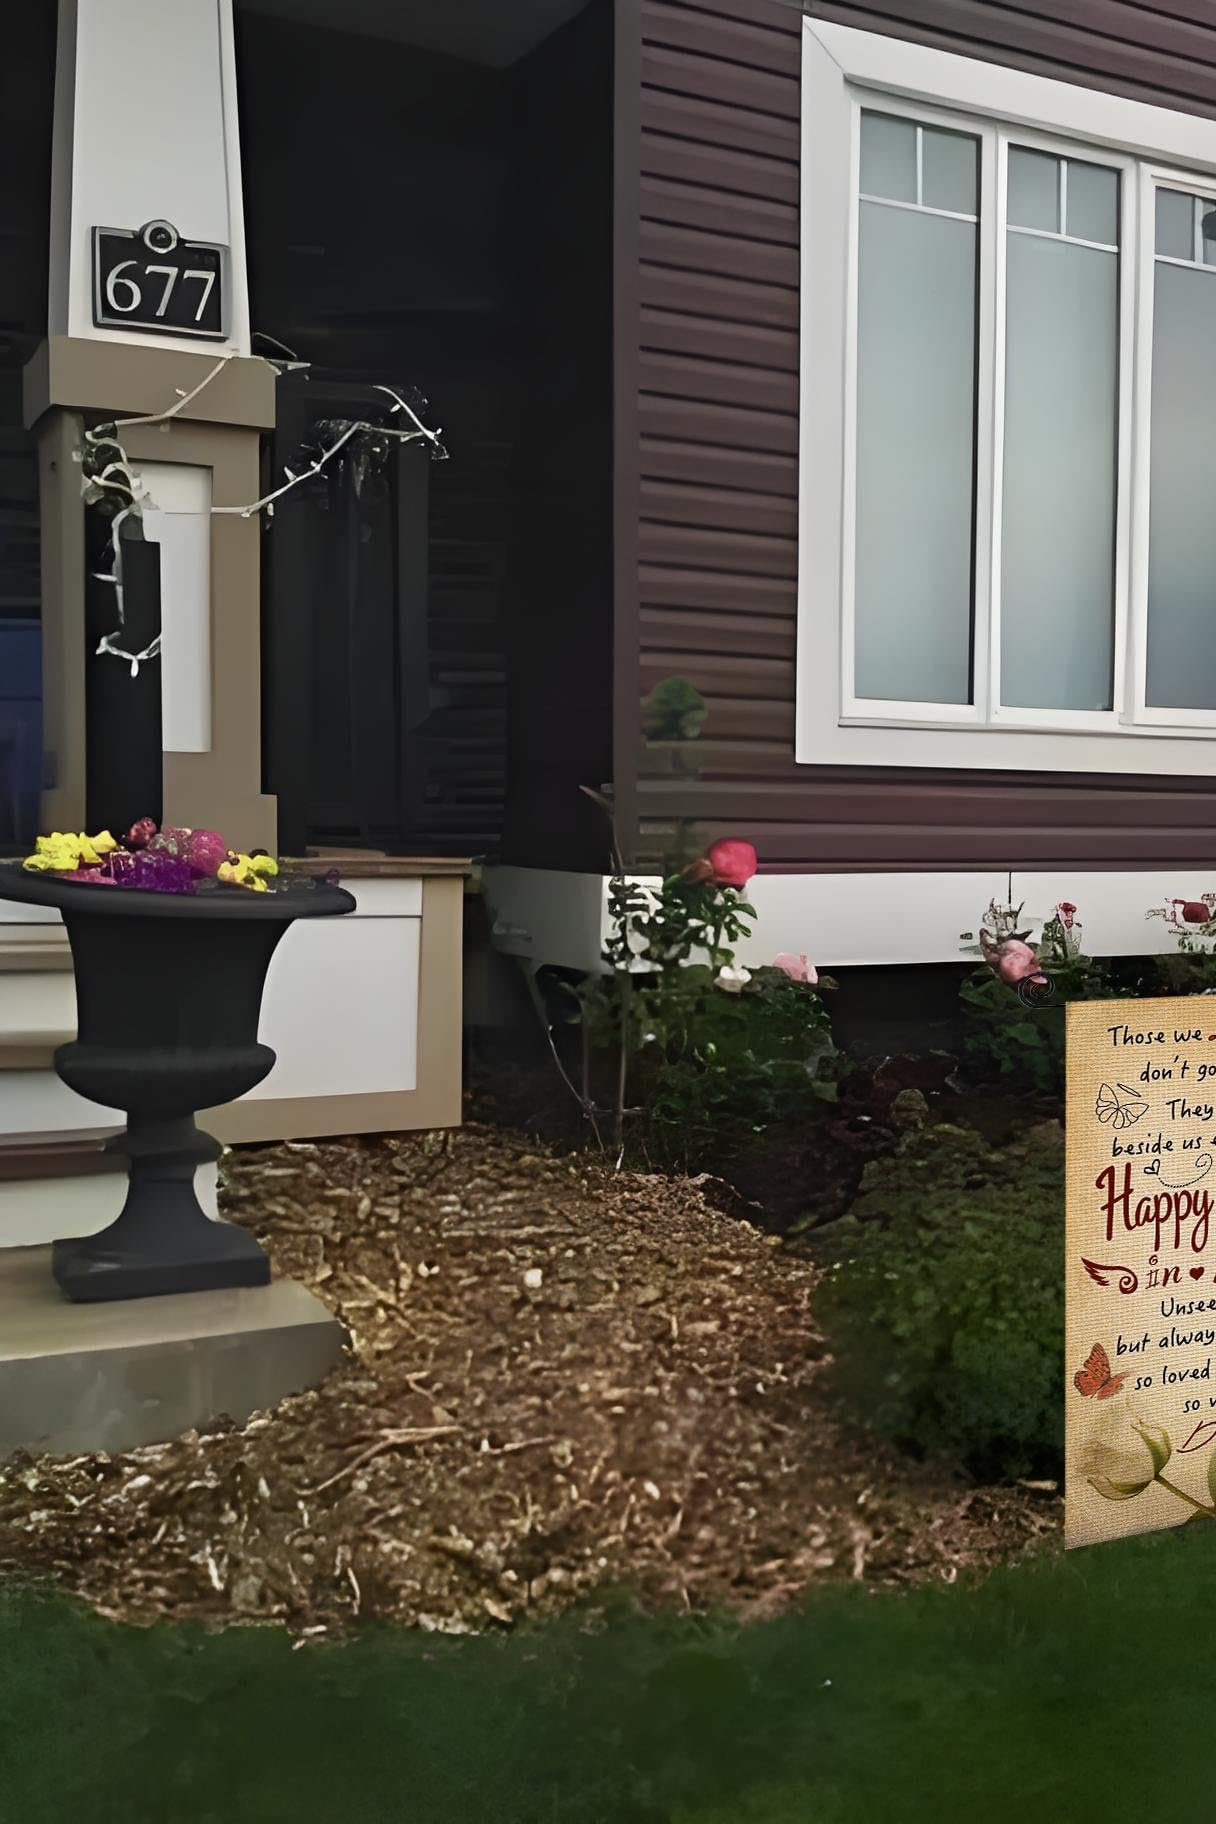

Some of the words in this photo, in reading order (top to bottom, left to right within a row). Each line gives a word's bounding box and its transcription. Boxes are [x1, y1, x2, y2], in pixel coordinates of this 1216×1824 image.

[106, 260, 216, 321] 677
[1107, 1025, 1166, 1047] Those
[1174, 1029, 1202, 1043] we
[1139, 1055, 1190, 1083] don't
[1198, 1063, 1216, 1081] go
[1165, 1097, 1214, 1121] They
[1111, 1135, 1173, 1158] beside
[1183, 1136, 1202, 1151] us
[1095, 1162, 1214, 1253] Happy
[1145, 1254, 1183, 1290] in
[1116, 1334, 1150, 1355] but
[1134, 1375, 1152, 1390] so
[1182, 1398, 1200, 1413] so
